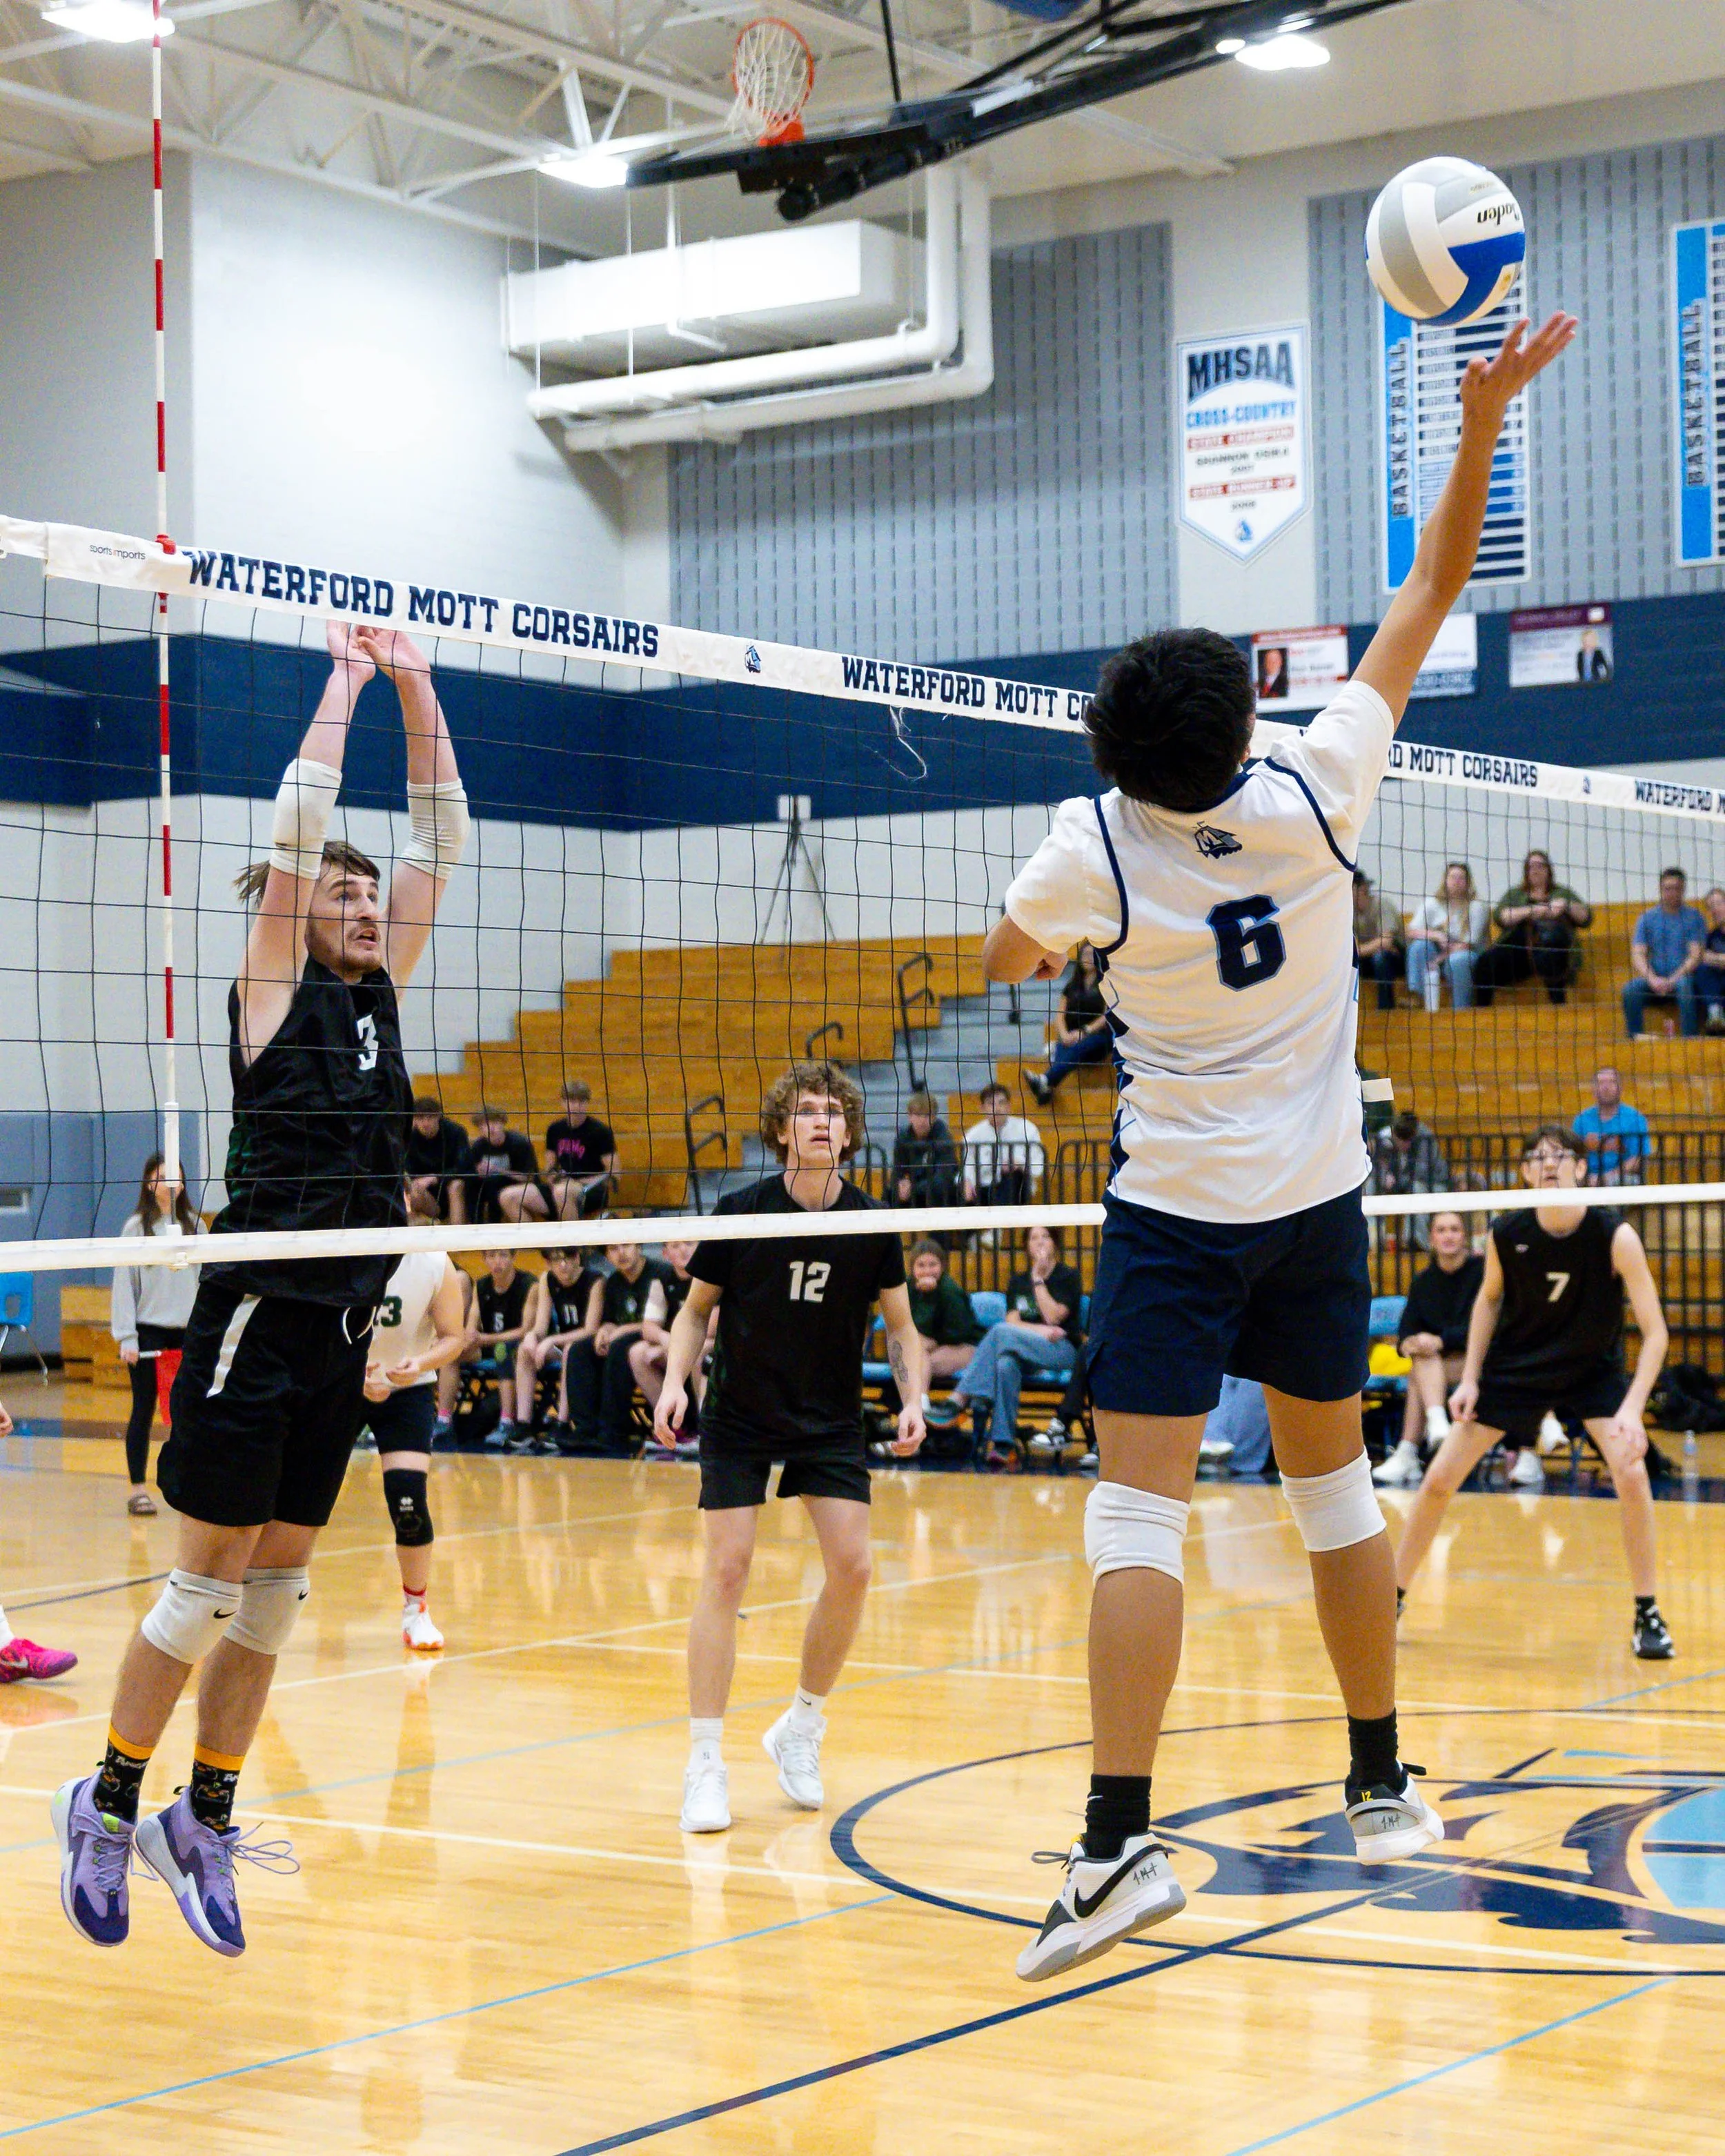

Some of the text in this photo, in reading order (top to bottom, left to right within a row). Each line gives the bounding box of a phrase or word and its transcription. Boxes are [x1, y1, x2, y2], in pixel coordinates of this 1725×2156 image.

[1187, 342, 1295, 406] MHSAA
[1682, 304, 1704, 486] BASKETBALL
[1389, 344, 1408, 515] BASKETBALL
[182, 550, 660, 658] WATERFORD MOTT CORSAIRS
[842, 655, 986, 708] WATERFORD
[996, 682, 1058, 718] MOTT
[1410, 746, 1456, 776] MOTT
[1463, 755, 1537, 787] CORSAIRS
[1635, 778, 1711, 811] WATERFORD
[1205, 894, 1287, 992] 6
[357, 1013, 379, 1071] 3
[789, 1260, 831, 1303] 12
[1546, 1272, 1570, 1303] 7
[373, 1295, 402, 1327] 3
[1361, 1790, 1374, 1802] 12
